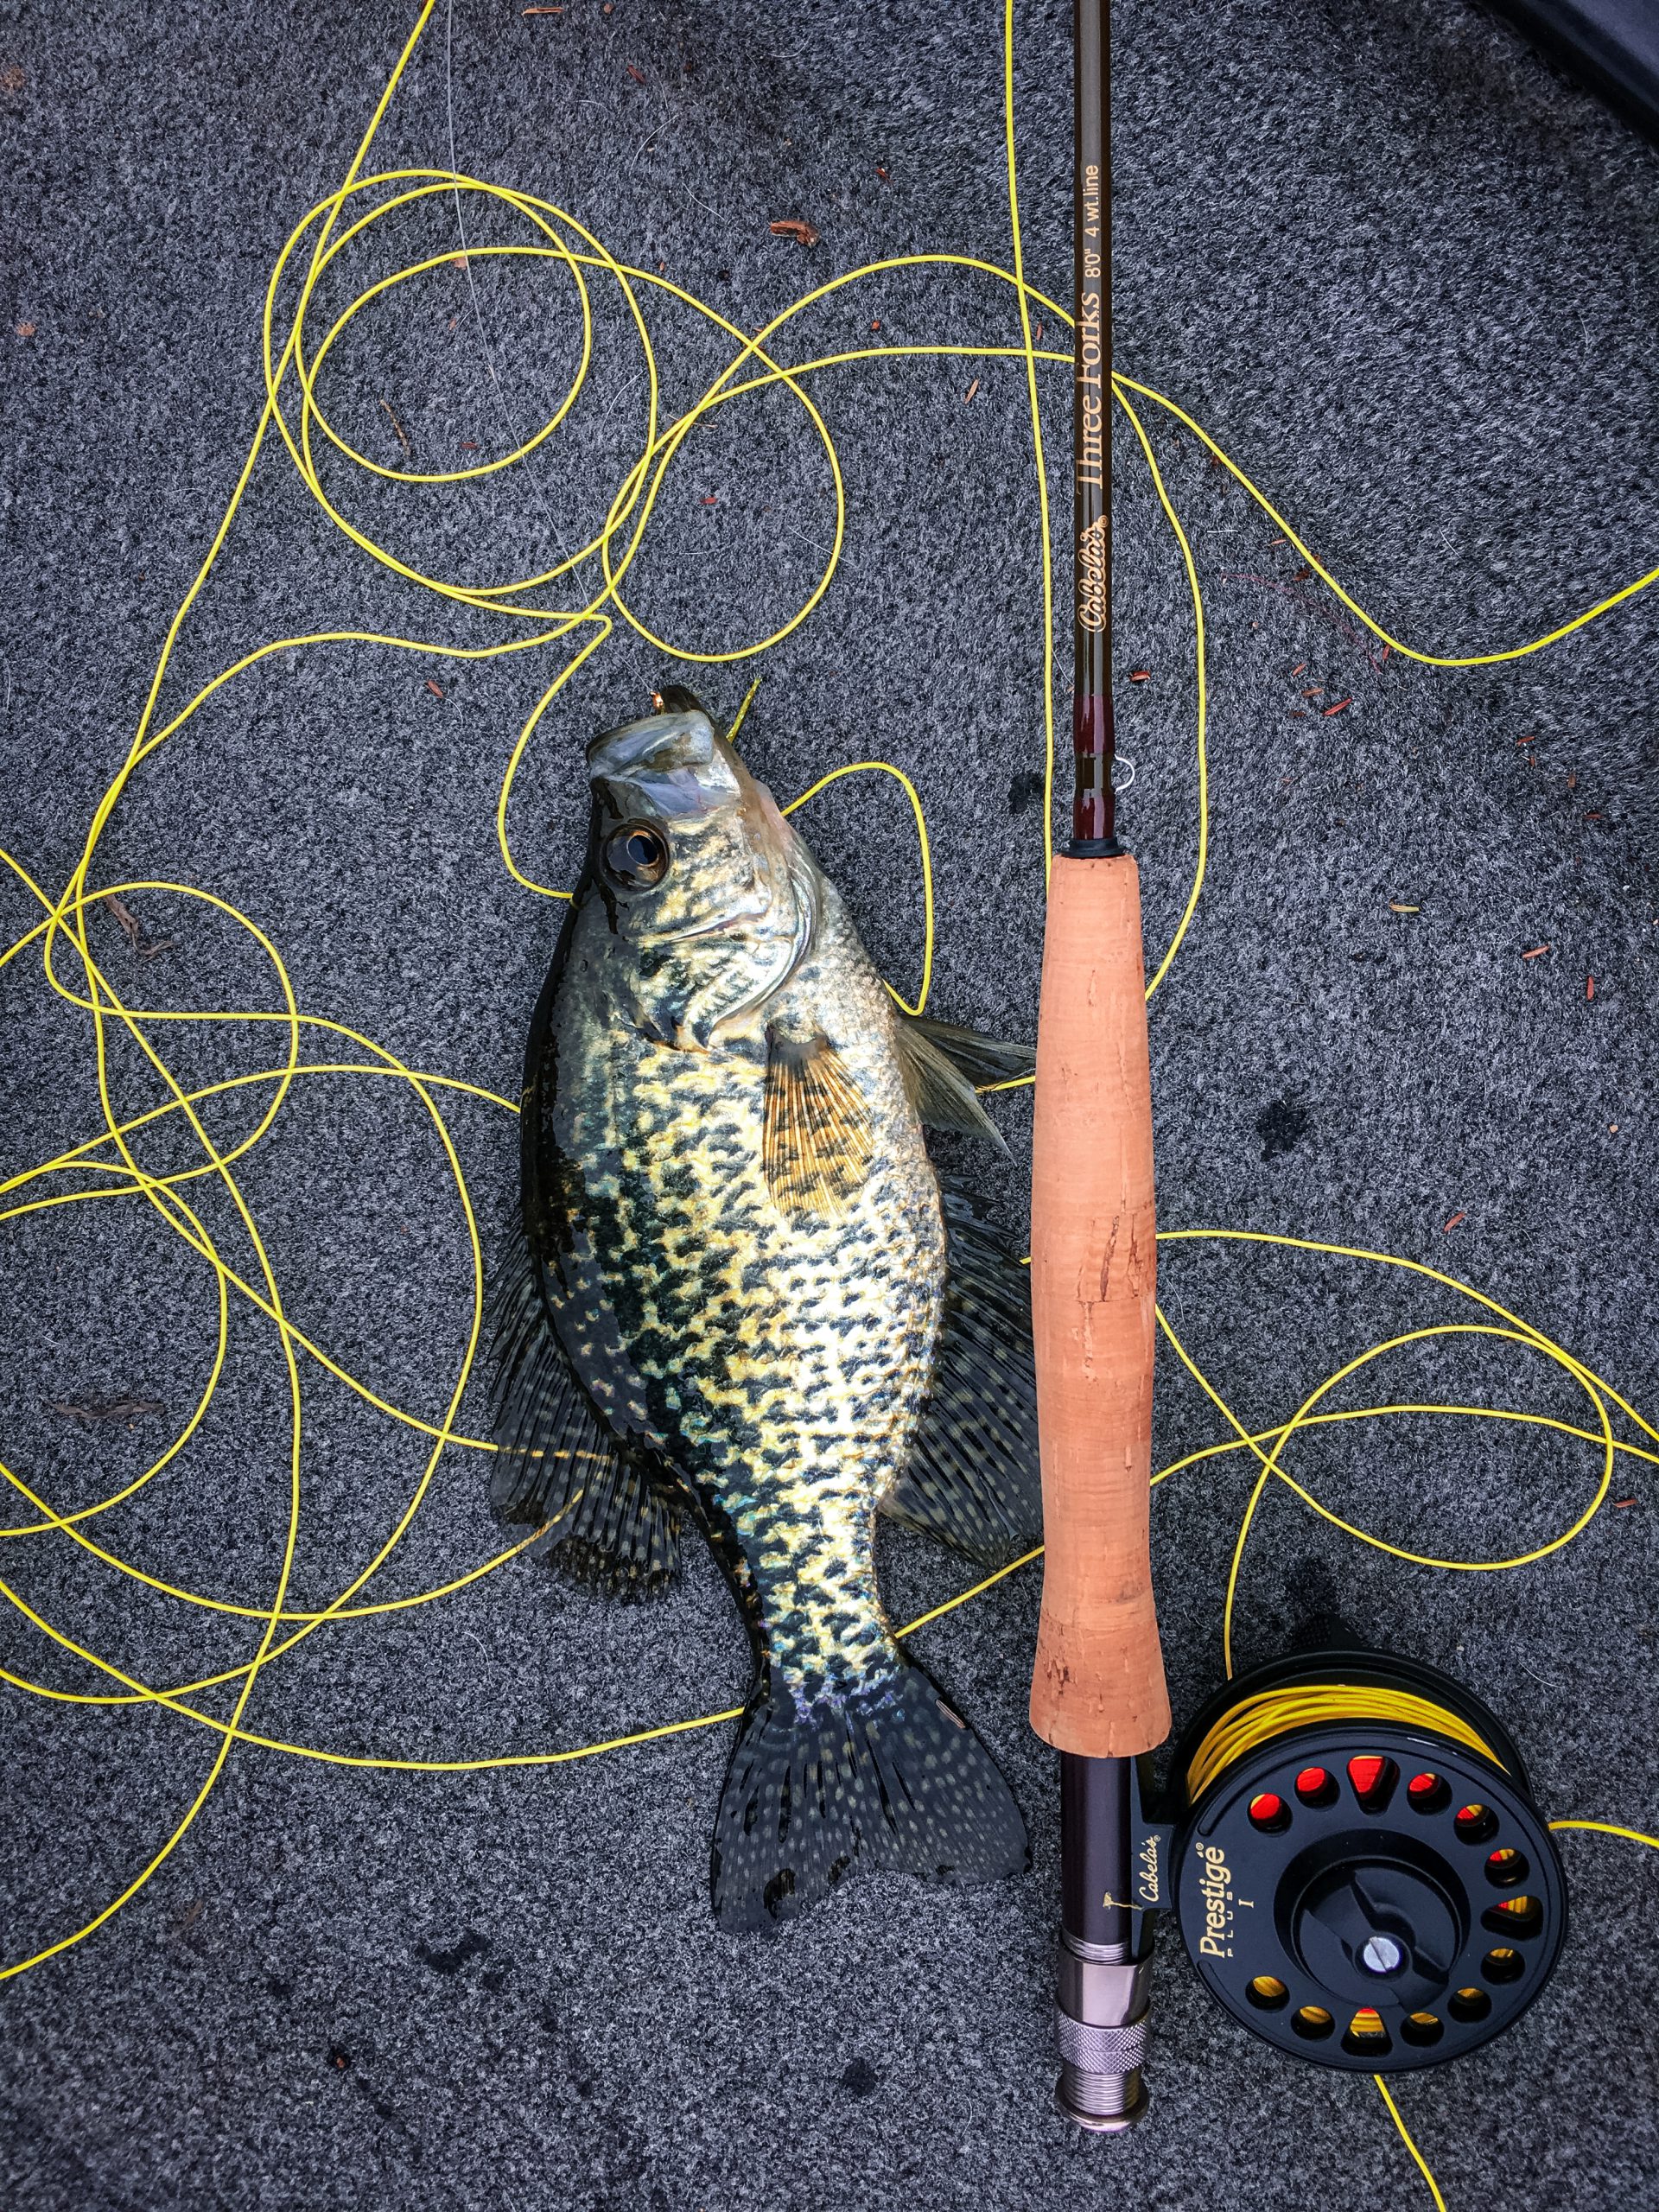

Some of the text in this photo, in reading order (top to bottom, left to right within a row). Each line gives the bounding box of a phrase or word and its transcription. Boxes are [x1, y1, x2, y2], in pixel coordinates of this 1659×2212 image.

[1084, 226, 1099, 237] 4
[1084, 248, 1101, 278] 8'0"
[1076, 292, 1102, 389] Forks
[1076, 395, 1103, 495] Three
[1077, 519, 1107, 632] Cabela's
[1139, 1836, 1159, 1901] Cabela's
